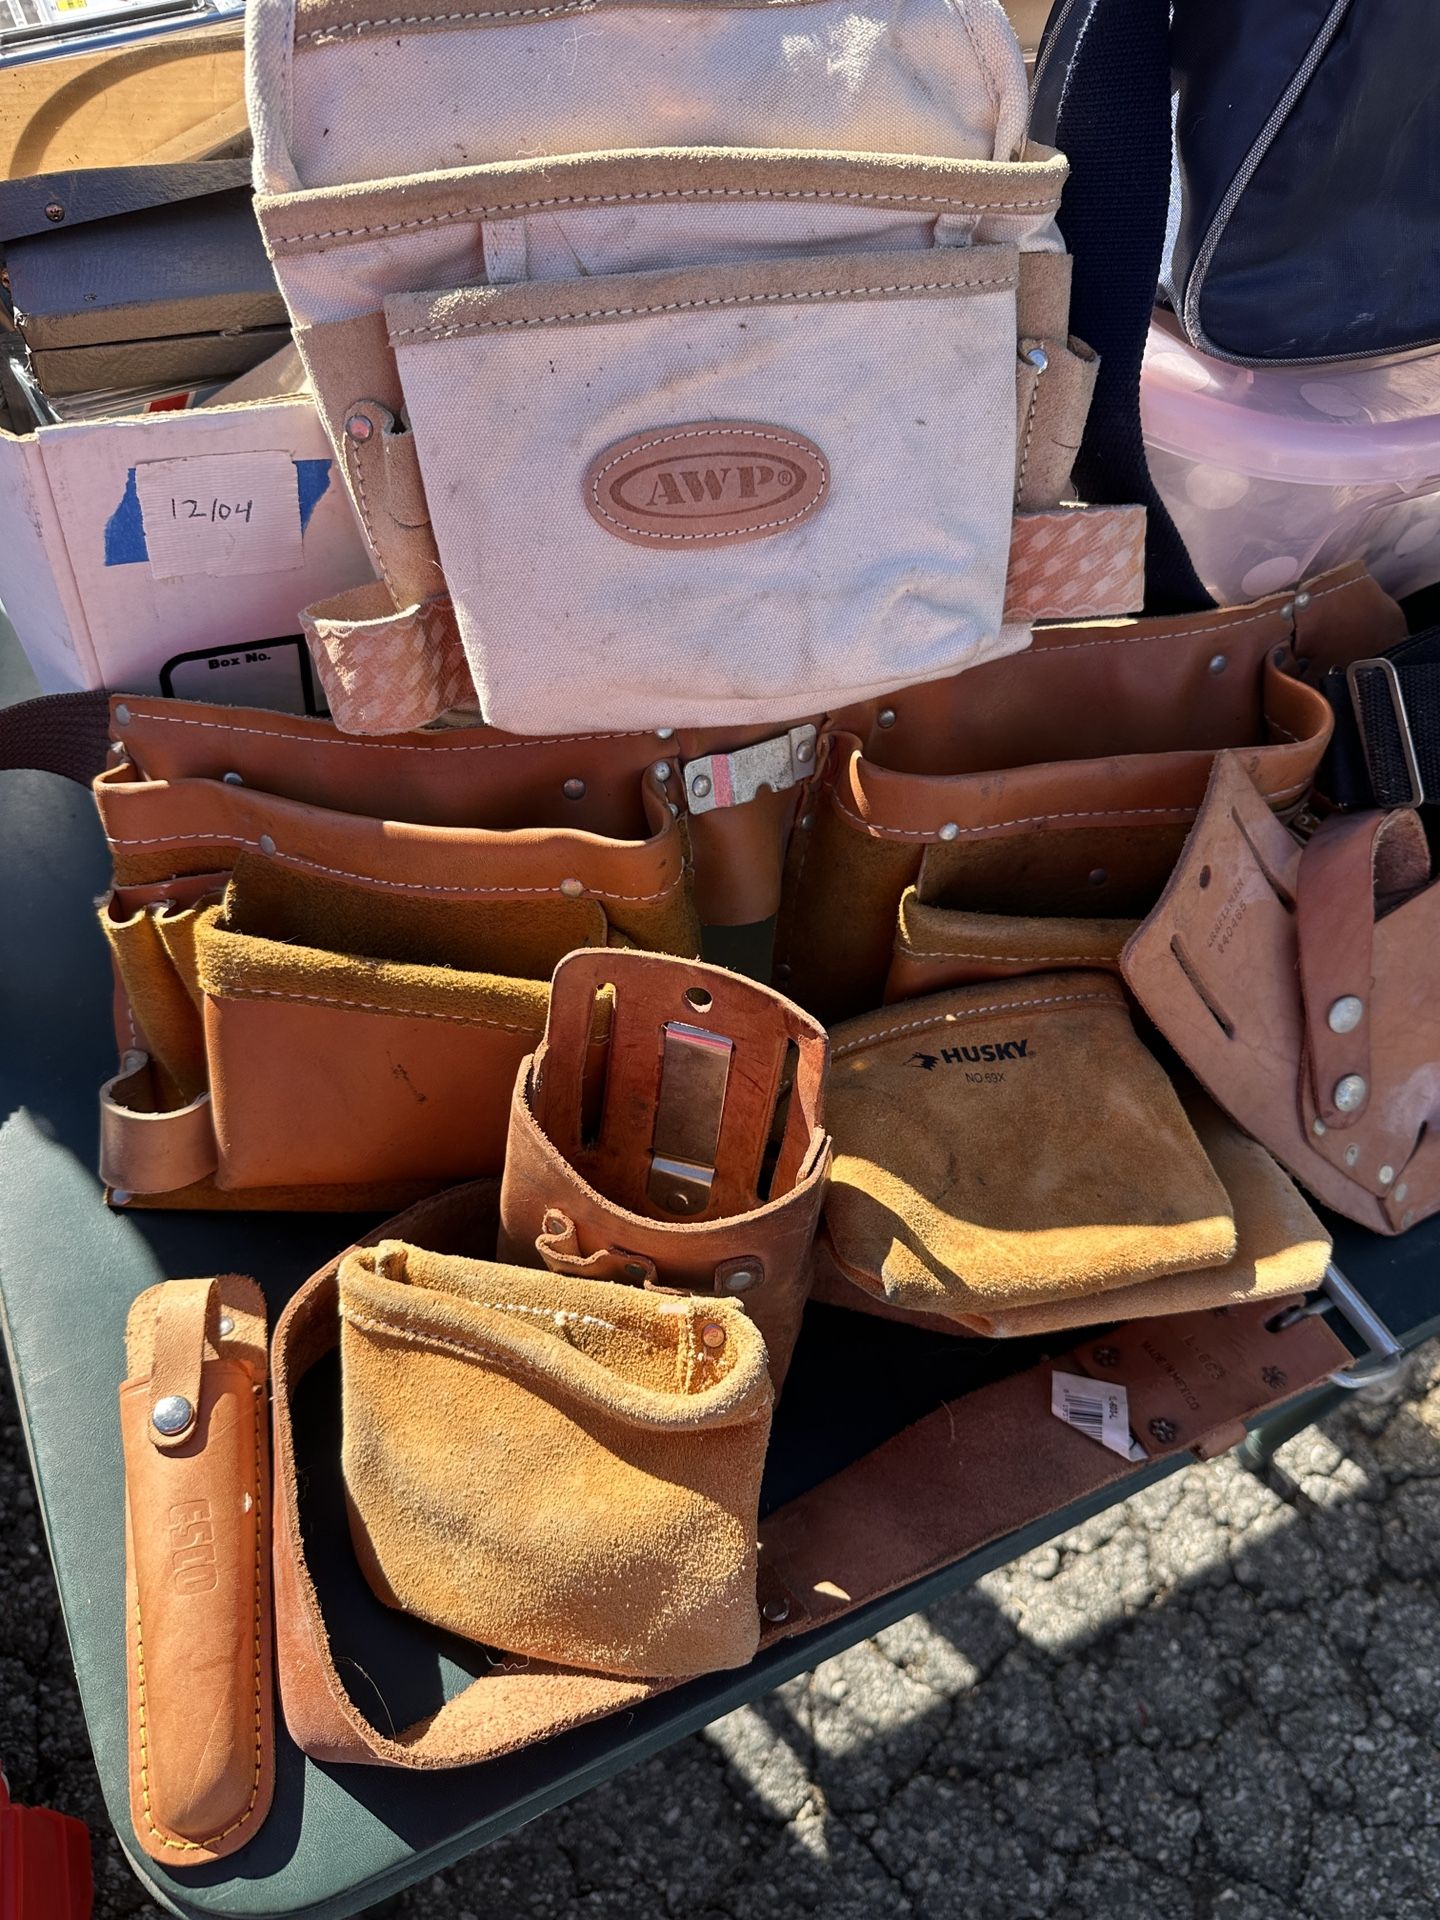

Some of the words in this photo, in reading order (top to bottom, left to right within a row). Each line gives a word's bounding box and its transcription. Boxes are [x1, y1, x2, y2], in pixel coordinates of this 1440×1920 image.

[171, 498, 253, 523] 12/04
[208, 656, 241, 670] Box
[245, 652, 272, 664] No.
[940, 1038, 1028, 1064] HUSKY
[168, 1498, 219, 1597] ESCO
